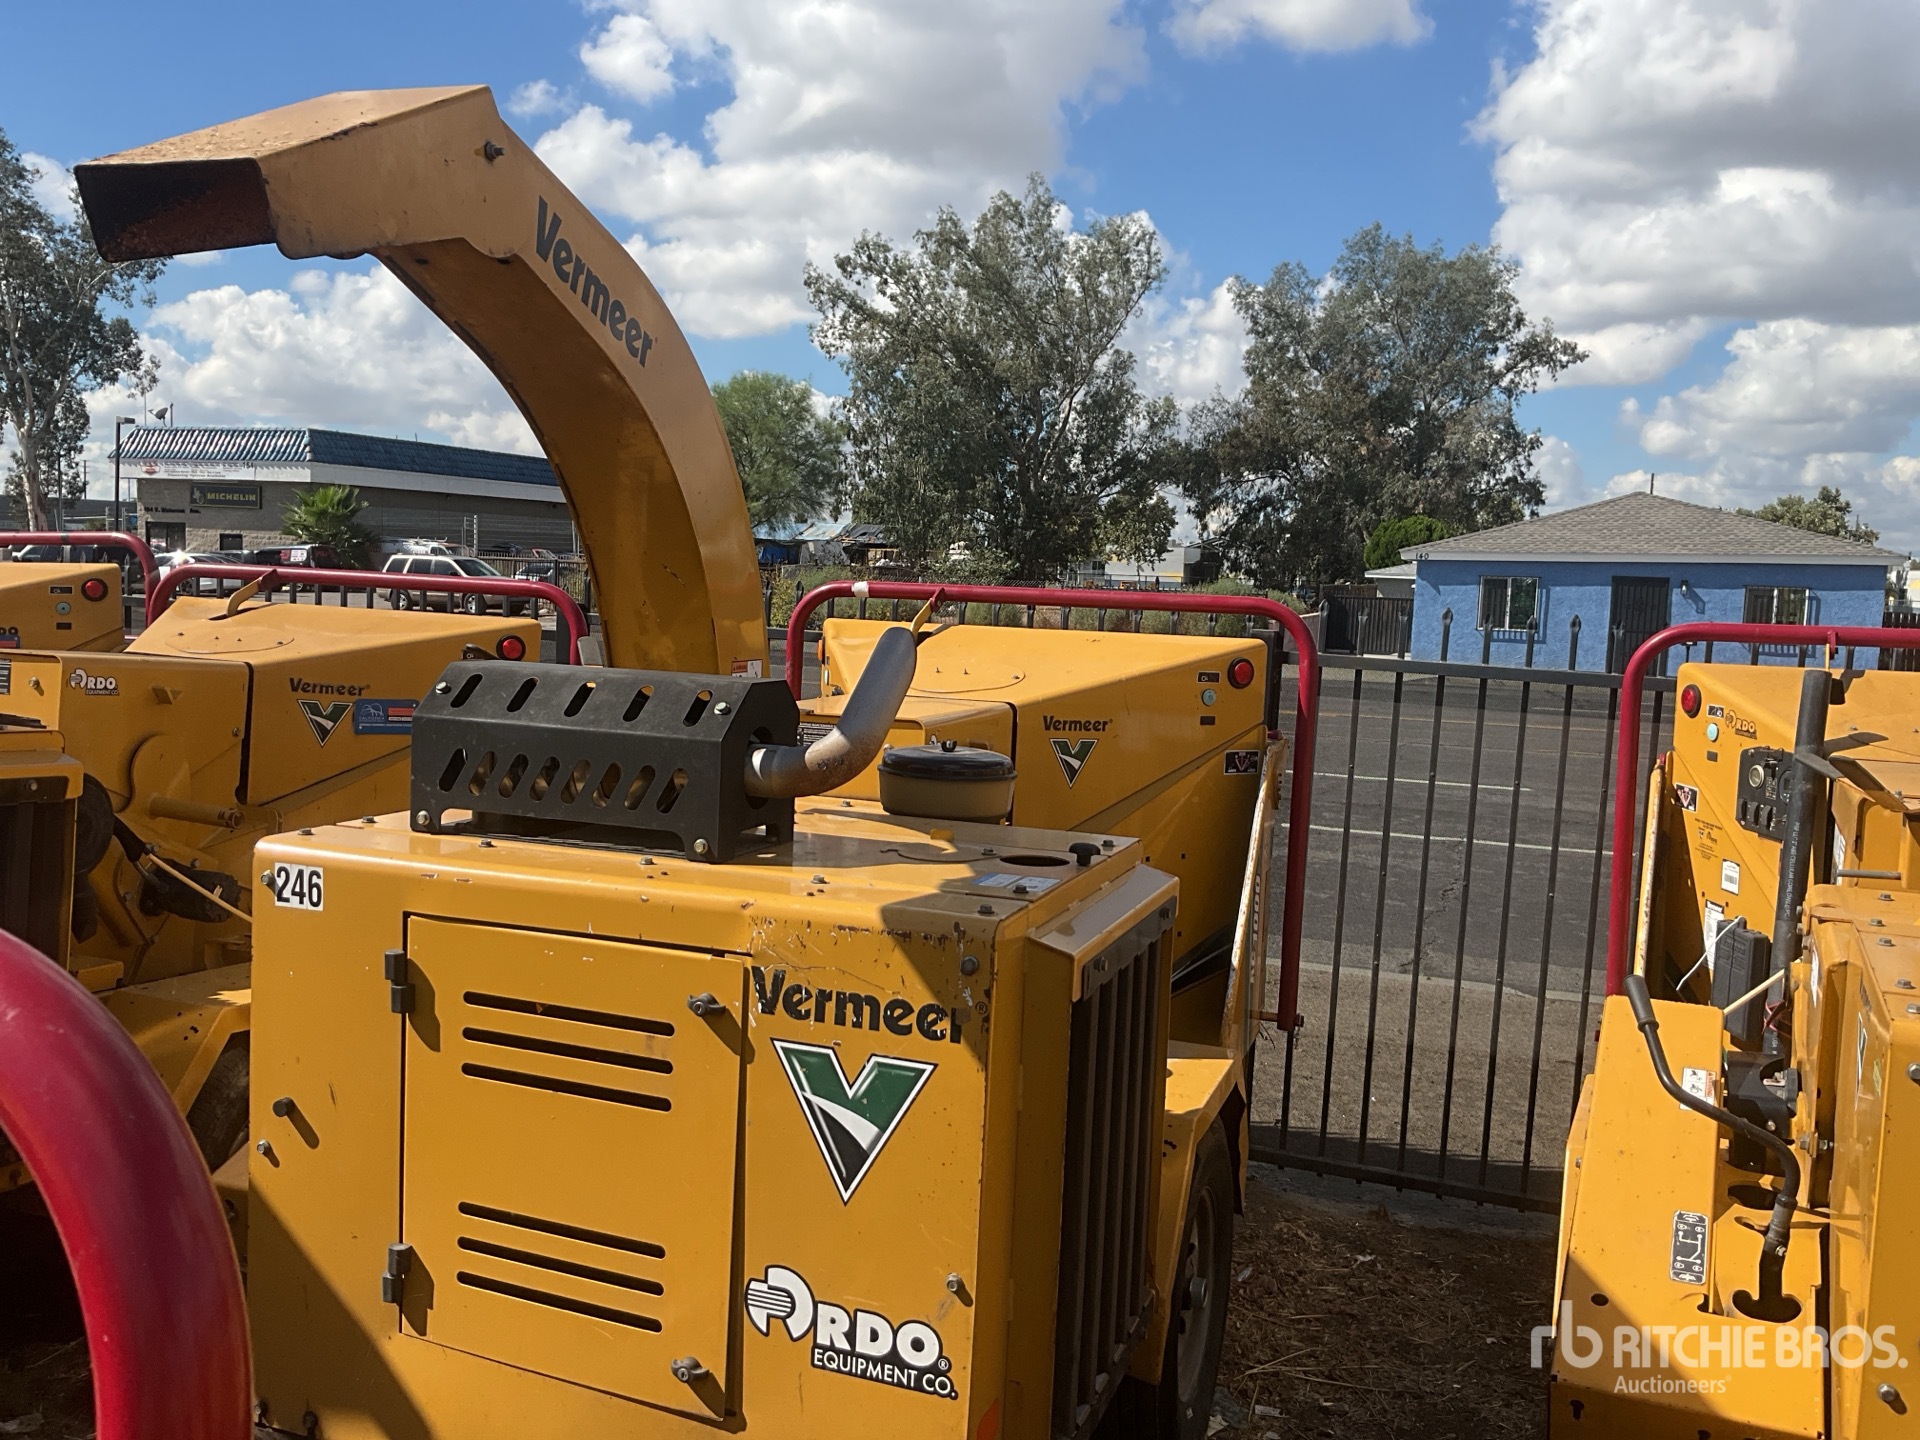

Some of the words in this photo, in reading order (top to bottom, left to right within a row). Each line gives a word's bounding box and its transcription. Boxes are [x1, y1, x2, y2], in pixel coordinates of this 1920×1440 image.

[536, 194, 653, 368] Vermeer
[207, 492, 256, 501] MICHELIN
[1415, 552, 1430, 560] 140
[289, 677, 365, 697] Vermeer
[1042, 715, 1108, 732] Vermeer
[276, 866, 322, 908] 246
[813, 1348, 917, 1389] EQUIPMENT
[922, 1372, 957, 1398] CO.
